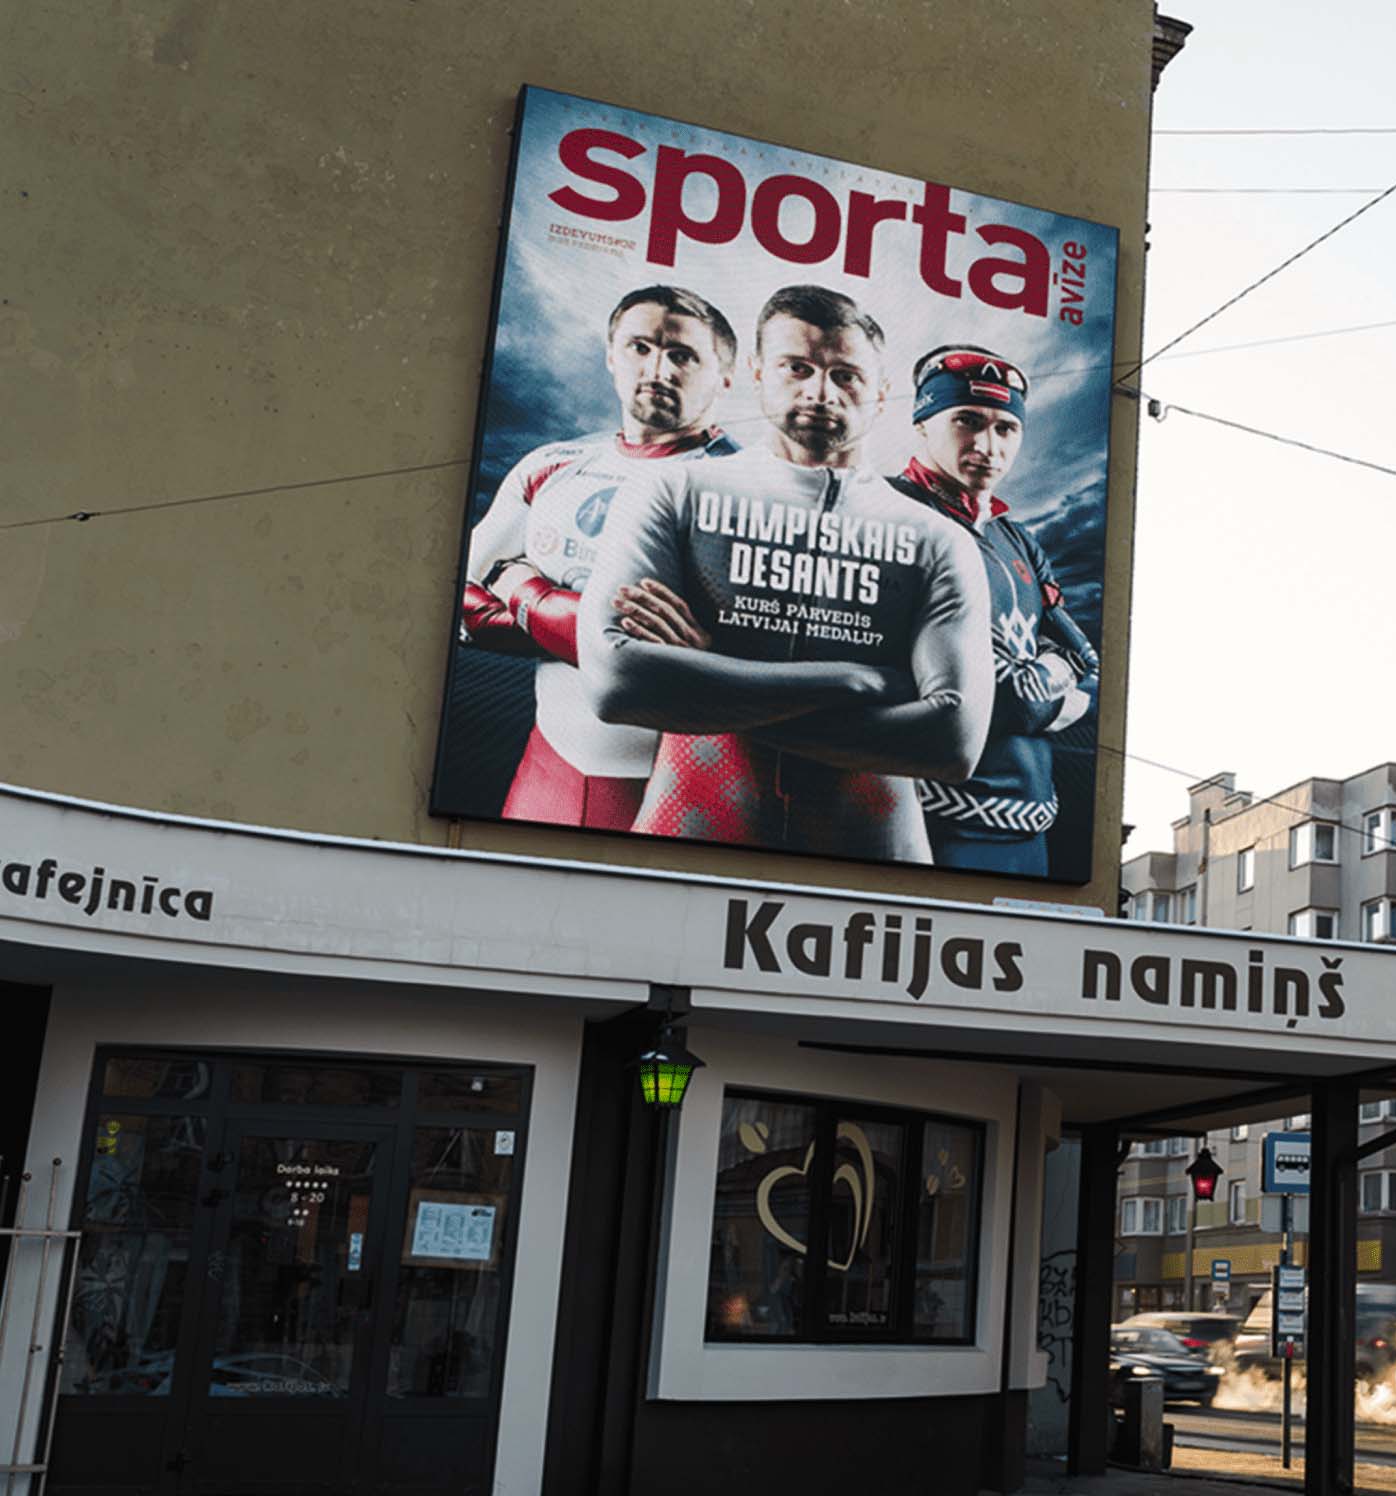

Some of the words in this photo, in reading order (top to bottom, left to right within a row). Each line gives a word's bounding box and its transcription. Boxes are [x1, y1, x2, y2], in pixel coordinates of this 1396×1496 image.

[547, 127, 1049, 318] sporta
[1053, 240, 1087, 326] avīze
[697, 491, 918, 566] OLIMPISKAIS
[728, 541, 881, 606] DESANTS
[734, 595, 781, 616] KURŠ
[717, 610, 800, 635] LATVIJAI
[0, 858, 214, 921] afejnīca
[723, 898, 1024, 1001] Kafijas
[1081, 949, 1346, 1029] namiņš
